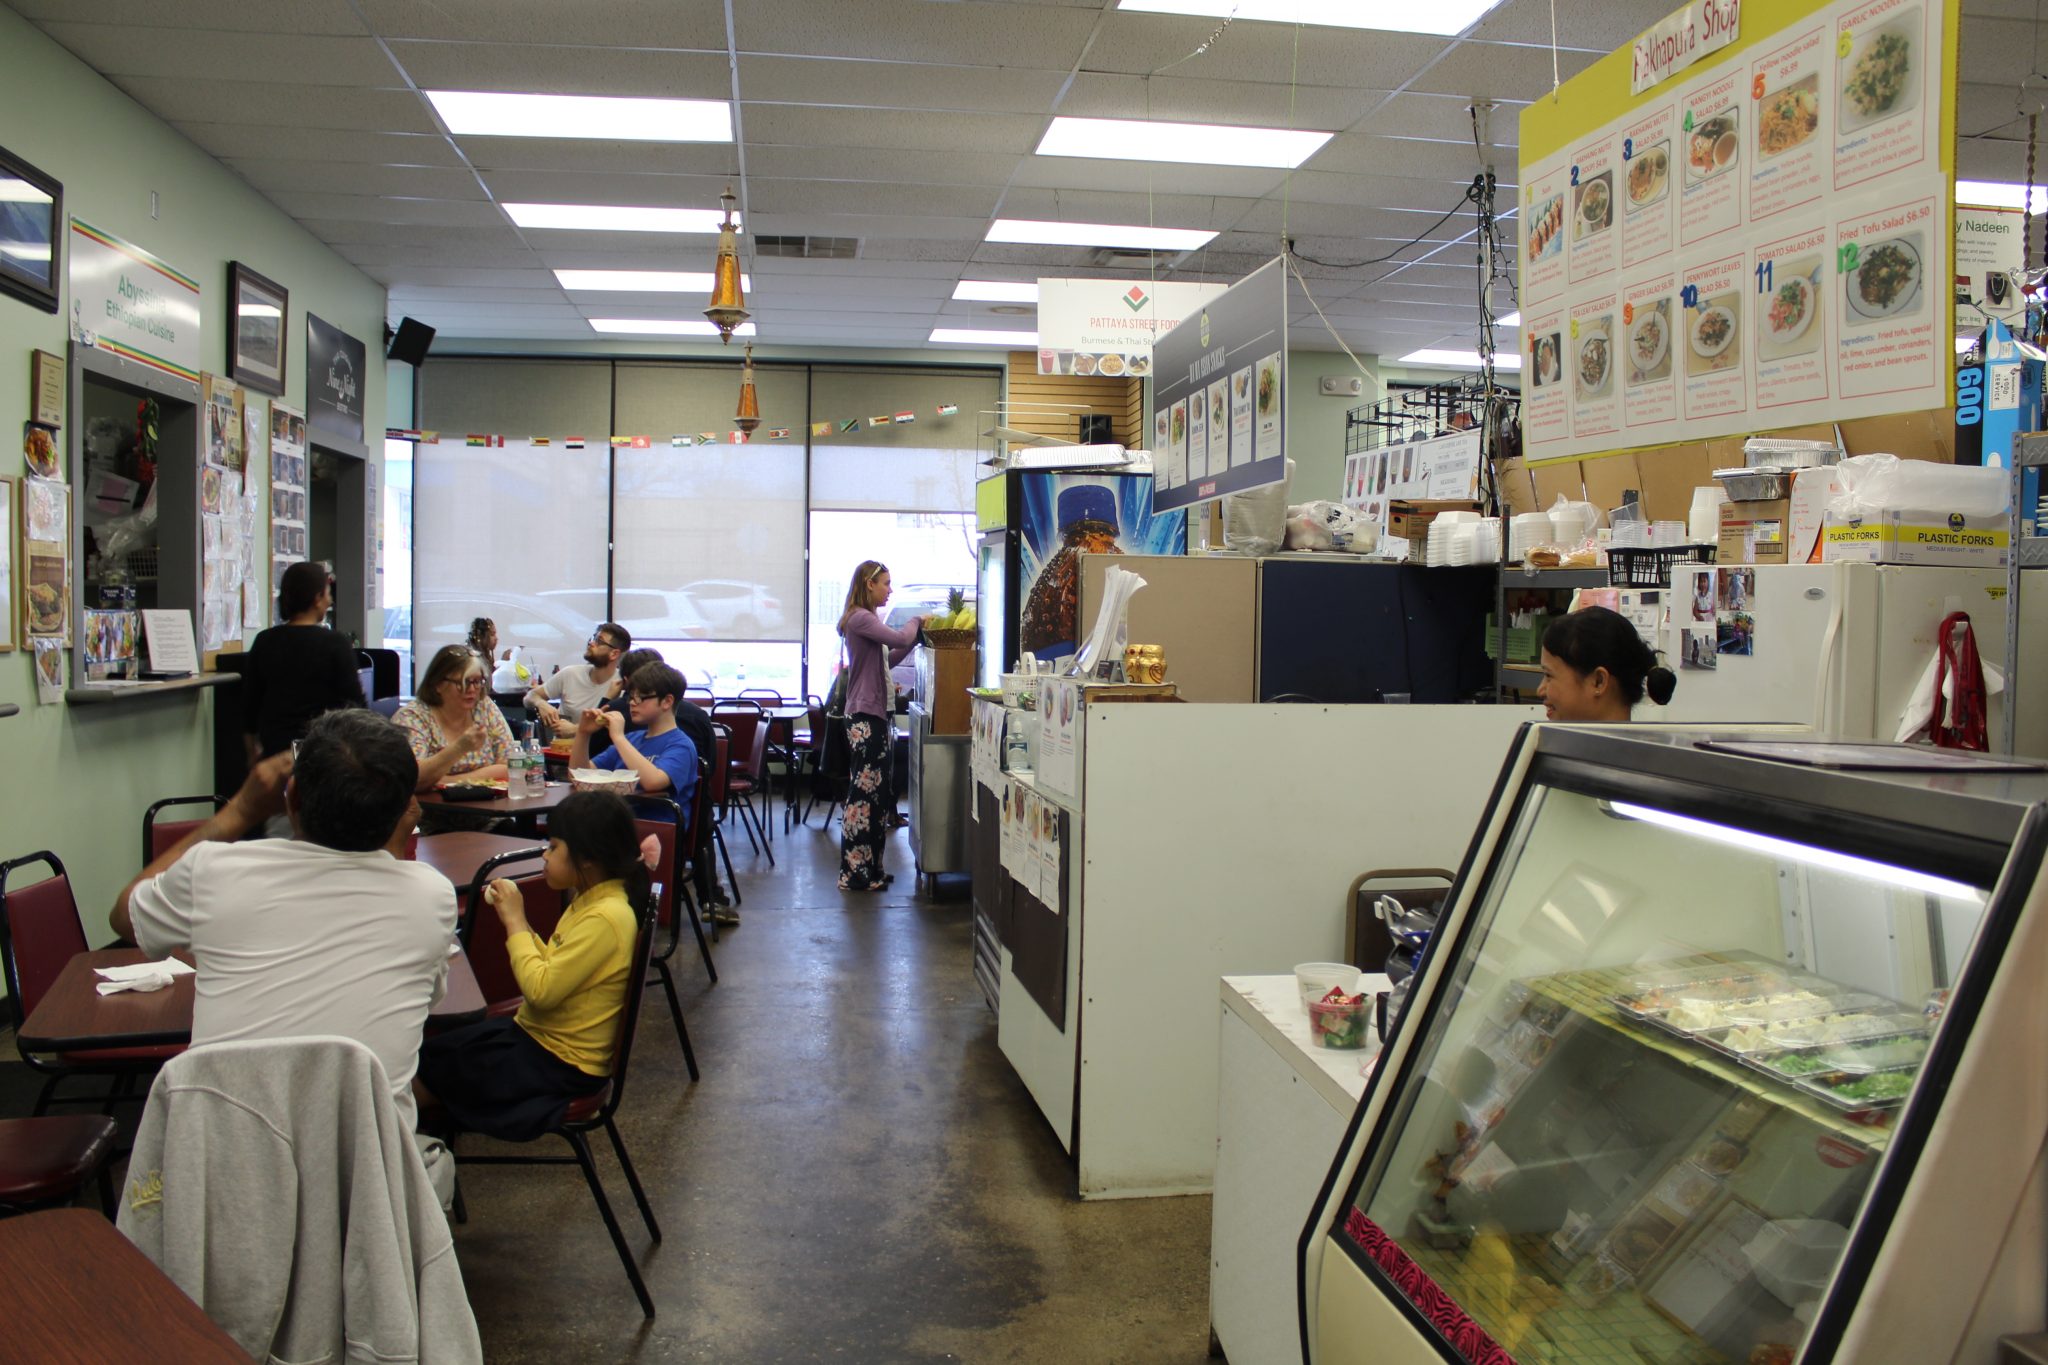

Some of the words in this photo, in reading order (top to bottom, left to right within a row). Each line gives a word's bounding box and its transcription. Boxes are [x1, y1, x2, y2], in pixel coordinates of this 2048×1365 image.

[1702, 0, 1738, 41] Shop
[1837, 31, 1853, 59] 6
[1752, 73, 1766, 100] 5
[1623, 138, 1633, 161] 3
[1570, 165, 1580, 187] 2
[1840, 229, 1859, 241] Fried
[1862, 222, 1880, 234] Tofu
[1882, 216, 1905, 231] Salad
[1906, 206, 1930, 224] $6.50
[1965, 220, 2010, 234] Nadeen
[1757, 247, 1784, 261] TOMATO
[1784, 241, 1806, 256] SALAD
[1806, 234, 1825, 249] $6.50
[1837, 242, 1860, 274] 12
[1720, 261, 1741, 275] LEAVES
[1755, 260, 1773, 293] 11
[117, 274, 167, 314] Abyssinia
[1680, 284, 1698, 309] 10
[106, 300, 147, 331] Ethiopian
[147, 317, 175, 343] Cuisine
[1090, 317, 1128, 330] PATTAYA
[1129, 318, 1158, 330] STREET
[1081, 336, 1117, 345] Burmese
[1118, 337, 1124, 345] &
[1125, 337, 1142, 346] Thai
[1956, 367, 1983, 426] 600
[1829, 531, 1855, 541] PLASTIC
[1856, 531, 1880, 540] FORKS
[1917, 532, 1959, 545] PLASTIC
[1961, 534, 1994, 546] FORKS
